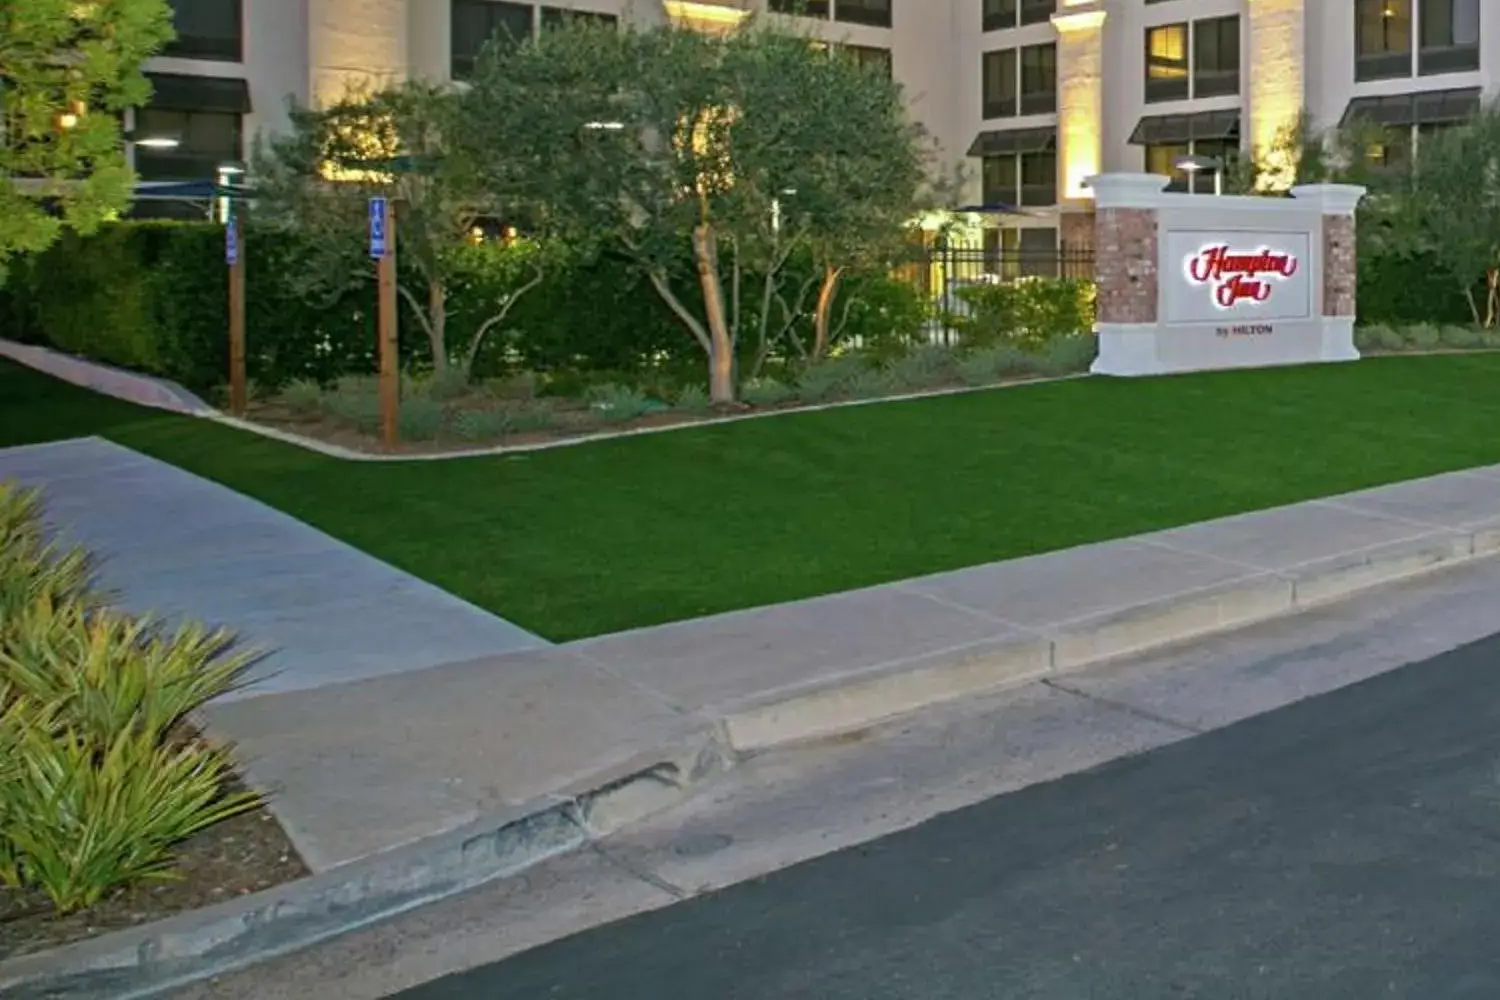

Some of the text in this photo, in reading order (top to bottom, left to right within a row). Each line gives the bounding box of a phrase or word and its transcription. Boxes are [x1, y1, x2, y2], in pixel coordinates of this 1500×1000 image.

[1190, 245, 1297, 281] Hampton
[1217, 274, 1271, 306] Inn
[1232, 324, 1273, 335] HILTON
